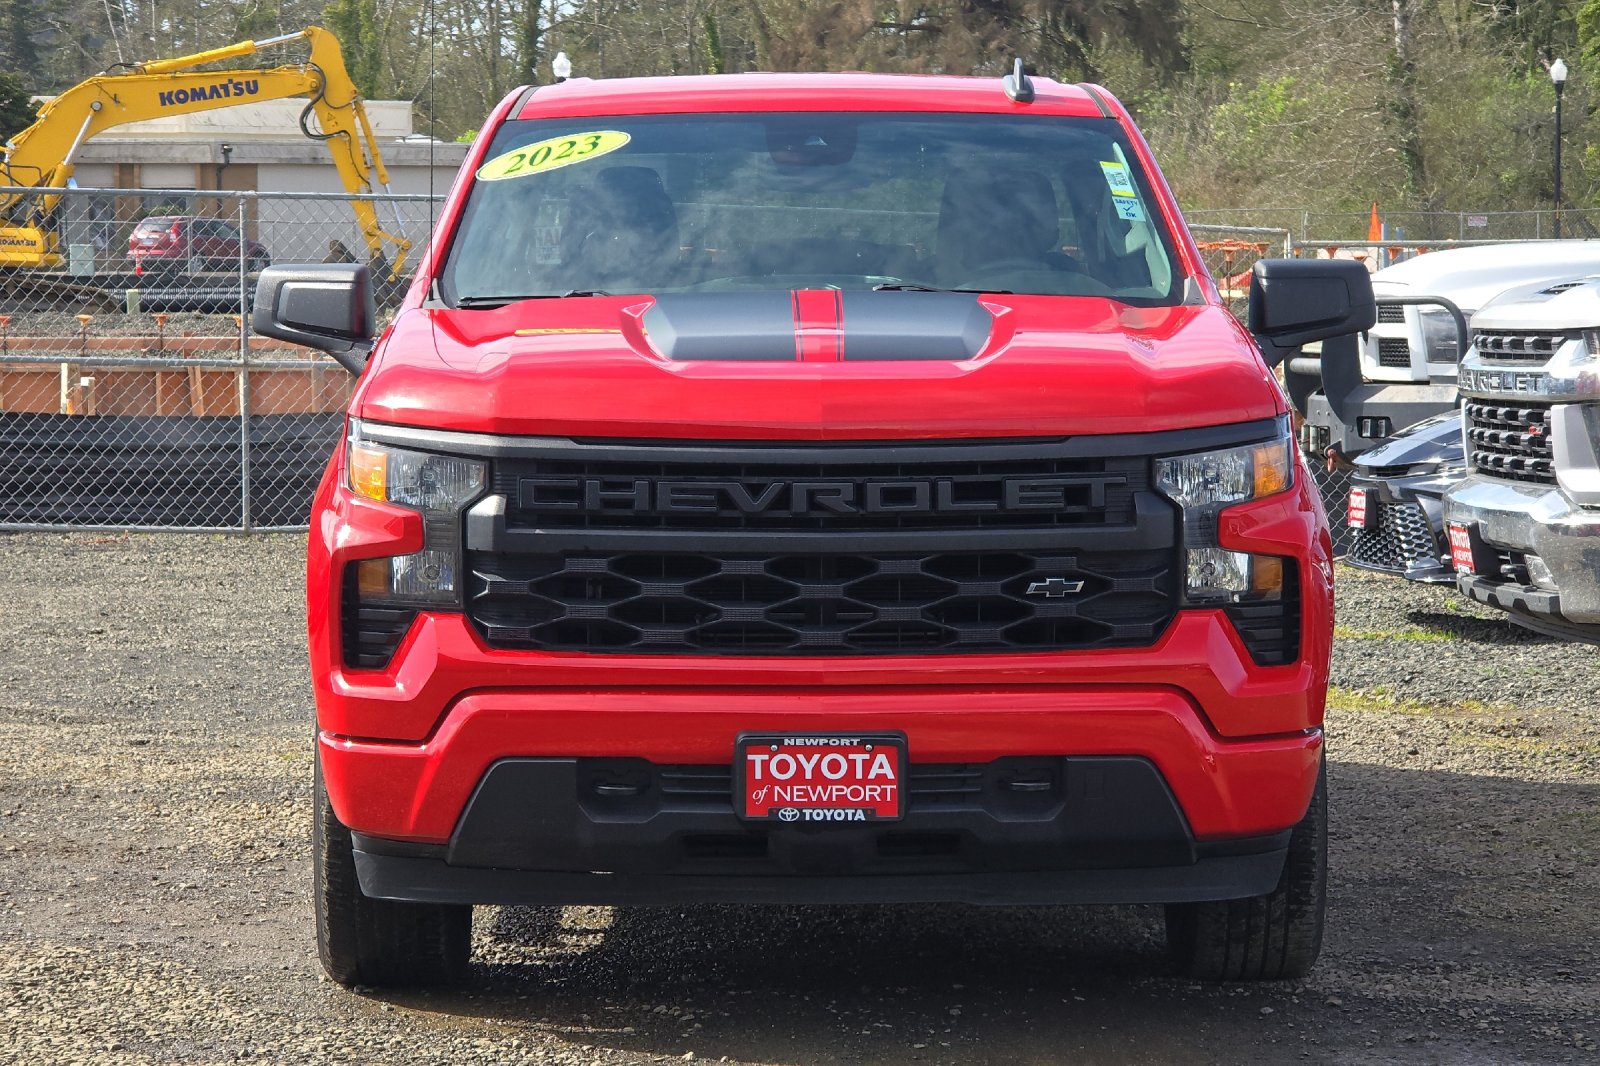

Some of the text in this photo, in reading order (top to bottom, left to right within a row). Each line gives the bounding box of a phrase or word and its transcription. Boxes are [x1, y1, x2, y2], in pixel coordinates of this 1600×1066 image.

[158, 78, 259, 106] KOMATSU
[502, 135, 602, 175] 2023
[518, 475, 1128, 512] CHEVROLET
[784, 738, 860, 746] NEWPORT
[747, 753, 895, 780] TOYOTA
[752, 784, 897, 805] of NEWPORT
[802, 809, 866, 821] TOYOTA
